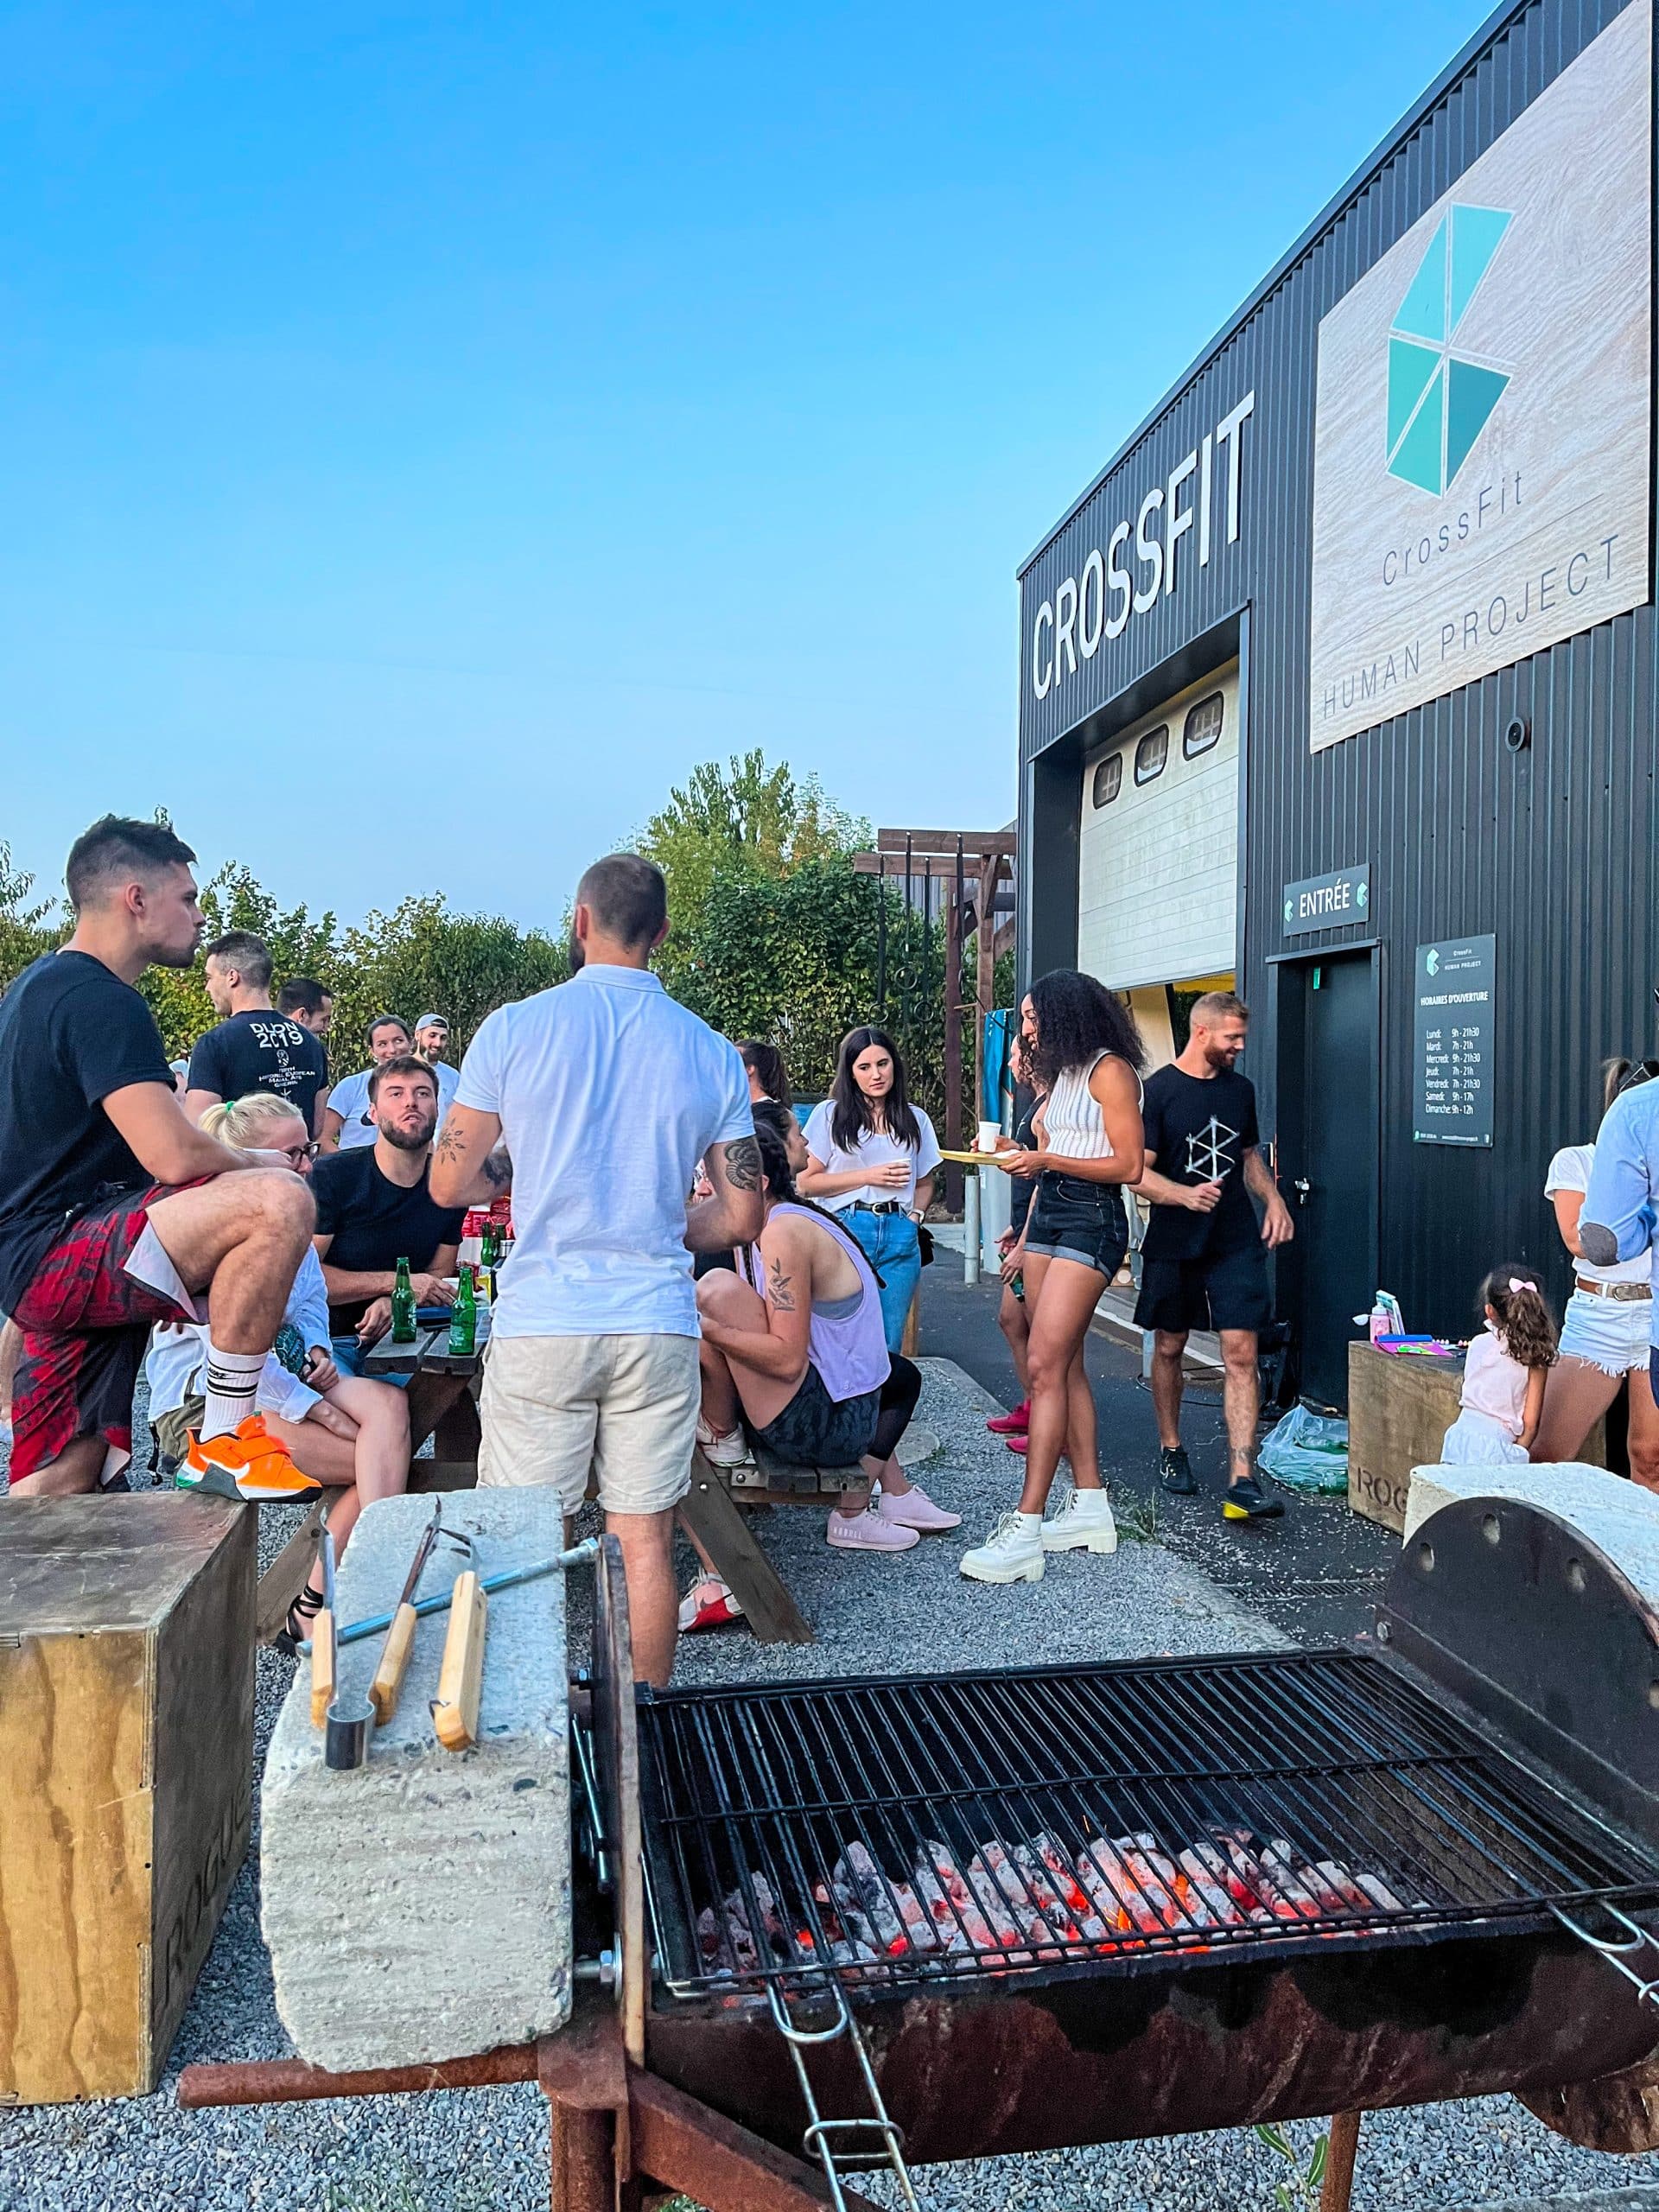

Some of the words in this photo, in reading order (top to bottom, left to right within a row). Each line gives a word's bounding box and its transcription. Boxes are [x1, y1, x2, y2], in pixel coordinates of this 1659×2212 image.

[1382, 471, 1522, 586] CrossFit
[1033, 390, 1255, 700] CROSSFIT
[1324, 640, 1420, 720] HUMAN
[1441, 534, 1619, 661] PROJECT
[1300, 877, 1351, 918] ENTRÉE
[1461, 960, 1482, 969] PROJECT
[1420, 995, 1448, 1006] HORAIRES
[1448, 990, 1489, 1003] D'OUVERTURE
[1463, 1027, 1480, 1038] 21h30
[1463, 1040, 1474, 1050] 21h
[1463, 1052, 1481, 1063] 21h30
[1463, 1065, 1474, 1076] 21h
[1463, 1078, 1481, 1089] 21h30
[1464, 1091, 1474, 1102] 17h
[1464, 1104, 1474, 1115] 12h
